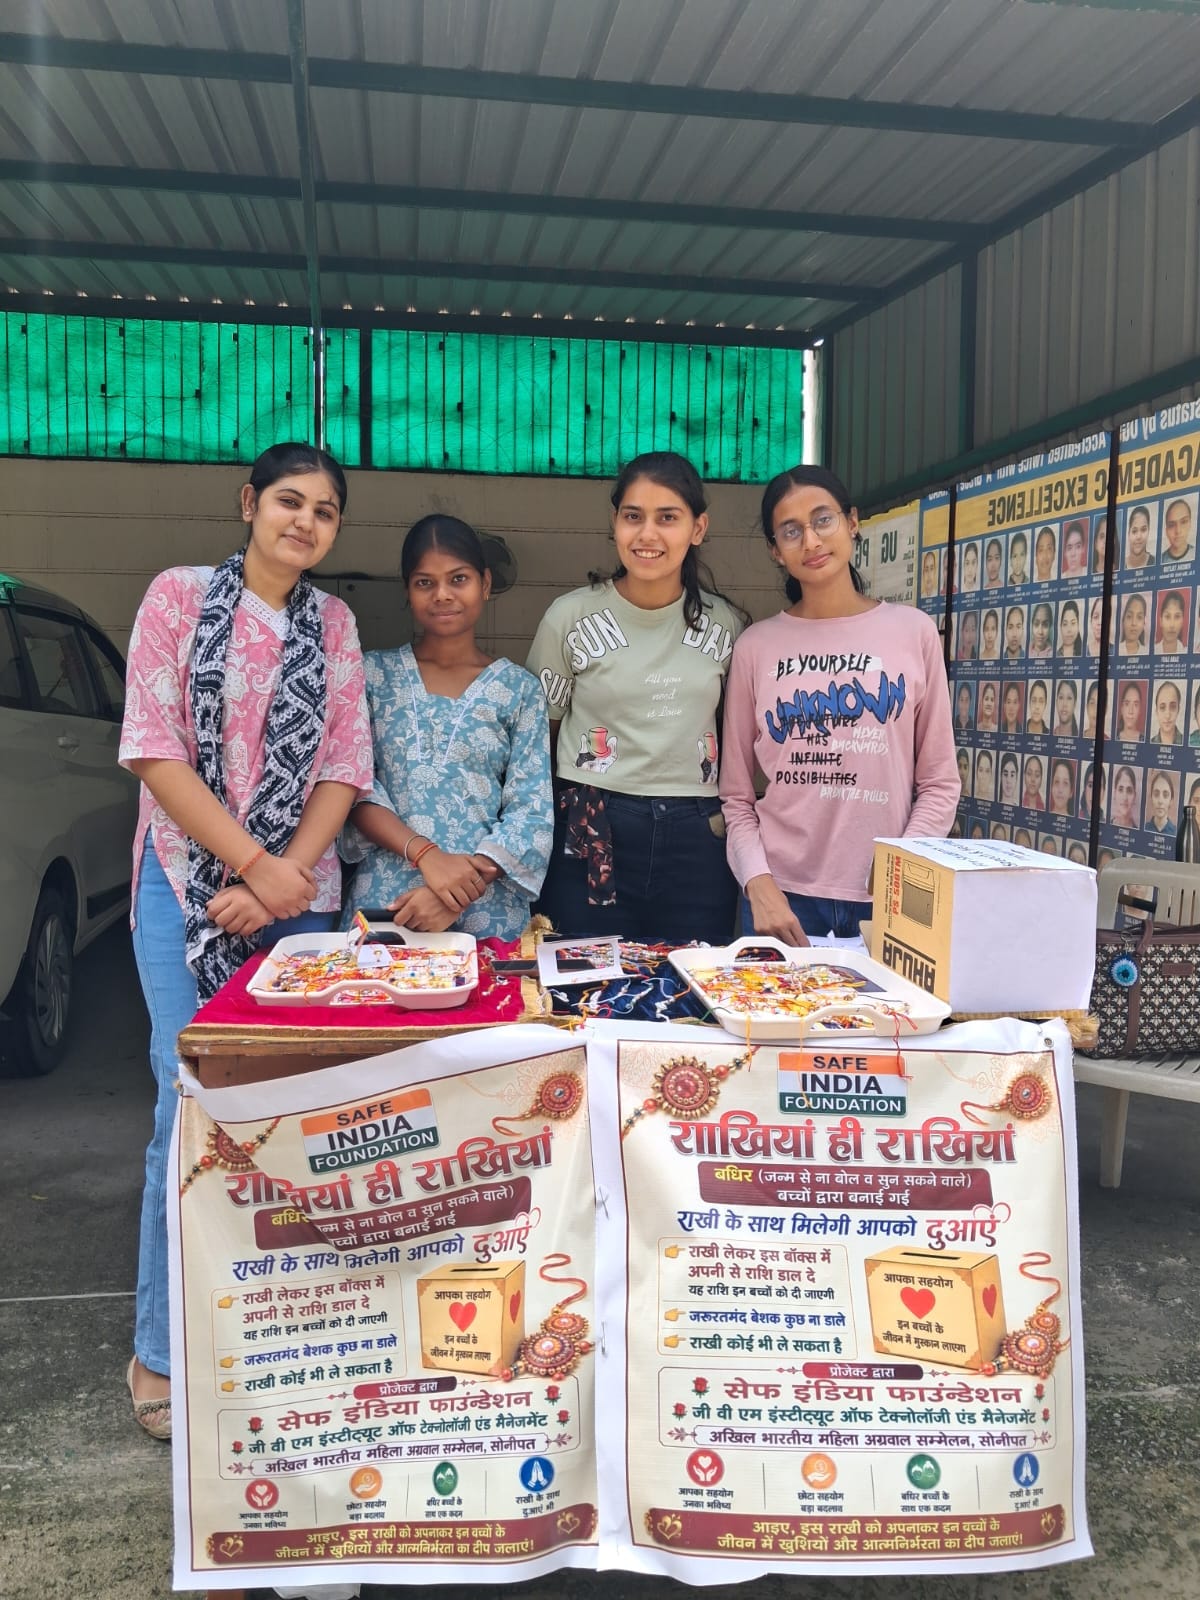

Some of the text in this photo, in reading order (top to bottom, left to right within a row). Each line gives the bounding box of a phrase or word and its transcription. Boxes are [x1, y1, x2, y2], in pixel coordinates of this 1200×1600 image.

[567, 608, 629, 671] SUN
[777, 653, 872, 681] BE YOURSELF
[765, 671, 906, 744] UNKNOWN
[790, 751, 842, 766] INFINITE
[776, 771, 857, 786] POSSIBILITIES
[882, 939, 936, 994] AHUJA
[813, 1055, 868, 1071] SAFE
[801, 1073, 883, 1095] INDIA
[337, 1101, 393, 1126] SAFE
[785, 1096, 901, 1112] FOUNDATION
[328, 1114, 412, 1151] INDIA
[827, 1116, 864, 1162] ही
[876, 1116, 1017, 1163] राखियां
[315, 1131, 434, 1170] FOUNDATION
[363, 1125, 553, 1205] ही राखियां
[714, 1165, 972, 1190] बधिर (जन्म से ना बोल व सुन सकने वाले)
[777, 1187, 910, 1206] बच्चों द्वारा बनाई गई
[677, 1208, 1001, 1251] राखी के साथ मिलेगी आपको दुआएं
[232, 1221, 532, 1281] राखी के साथ मिलेगी आपको दुआएं
[689, 1243, 831, 1264] राखी लेकर इस बॉक्स में
[688, 1262, 816, 1284] अपनी से राशि डाल दे
[884, 1273, 953, 1288] आपका सहयोग
[688, 1283, 834, 1300] यह राशि इन बच्चों को दी जाएगी
[689, 1308, 846, 1329] जरूरतमंद बेशक कुछ ना डाले
[935, 1322, 944, 1335] के
[690, 1333, 842, 1354] राखी कोई भी ले सकता है
[829, 1363, 895, 1379] प्रोजेक्ट द्वारा
[723, 1377, 782, 1400] सेफ
[792, 1379, 874, 1403] इंडिया
[277, 1410, 332, 1431] सेफ
[342, 1398, 420, 1425] इंडिया
[692, 1403, 711, 1420] जी
[717, 1403, 732, 1421] वी
[738, 1408, 762, 1421] एम
[840, 1406, 873, 1423] ऑफ
[878, 1406, 951, 1424] टेक्नोलॉजी
[955, 1409, 976, 1425] एंड
[982, 1408, 1036, 1425] मैनेजमेंट
[249, 1437, 266, 1454] जी
[271, 1437, 286, 1453] वी
[291, 1435, 314, 1450] एम
[388, 1421, 416, 1436] ऑफ
[420, 1415, 471, 1435] टेक्नोलॉजी
[475, 1415, 491, 1431] एंड
[495, 1412, 548, 1429] मैनेजमेंट
[709, 1427, 1027, 1449] अखिल भारतीय महिला अग्रवाल सम्मेलन, सोनीपत
[752, 1521, 795, 1536] आइए,
[801, 1522, 822, 1535] इस
[828, 1519, 860, 1535] राखी
[865, 1519, 882, 1534] को
[886, 1522, 939, 1534] अपनाकर
[943, 1522, 959, 1534] इन
[990, 1517, 1001, 1531] के
[717, 1534, 756, 1549] जीवन
[761, 1535, 773, 1550] में
[778, 1535, 828, 1554] खुशियों
[833, 1535, 857, 1550] और
[944, 1539, 961, 1551] का
[964, 1535, 985, 1549] दीप
